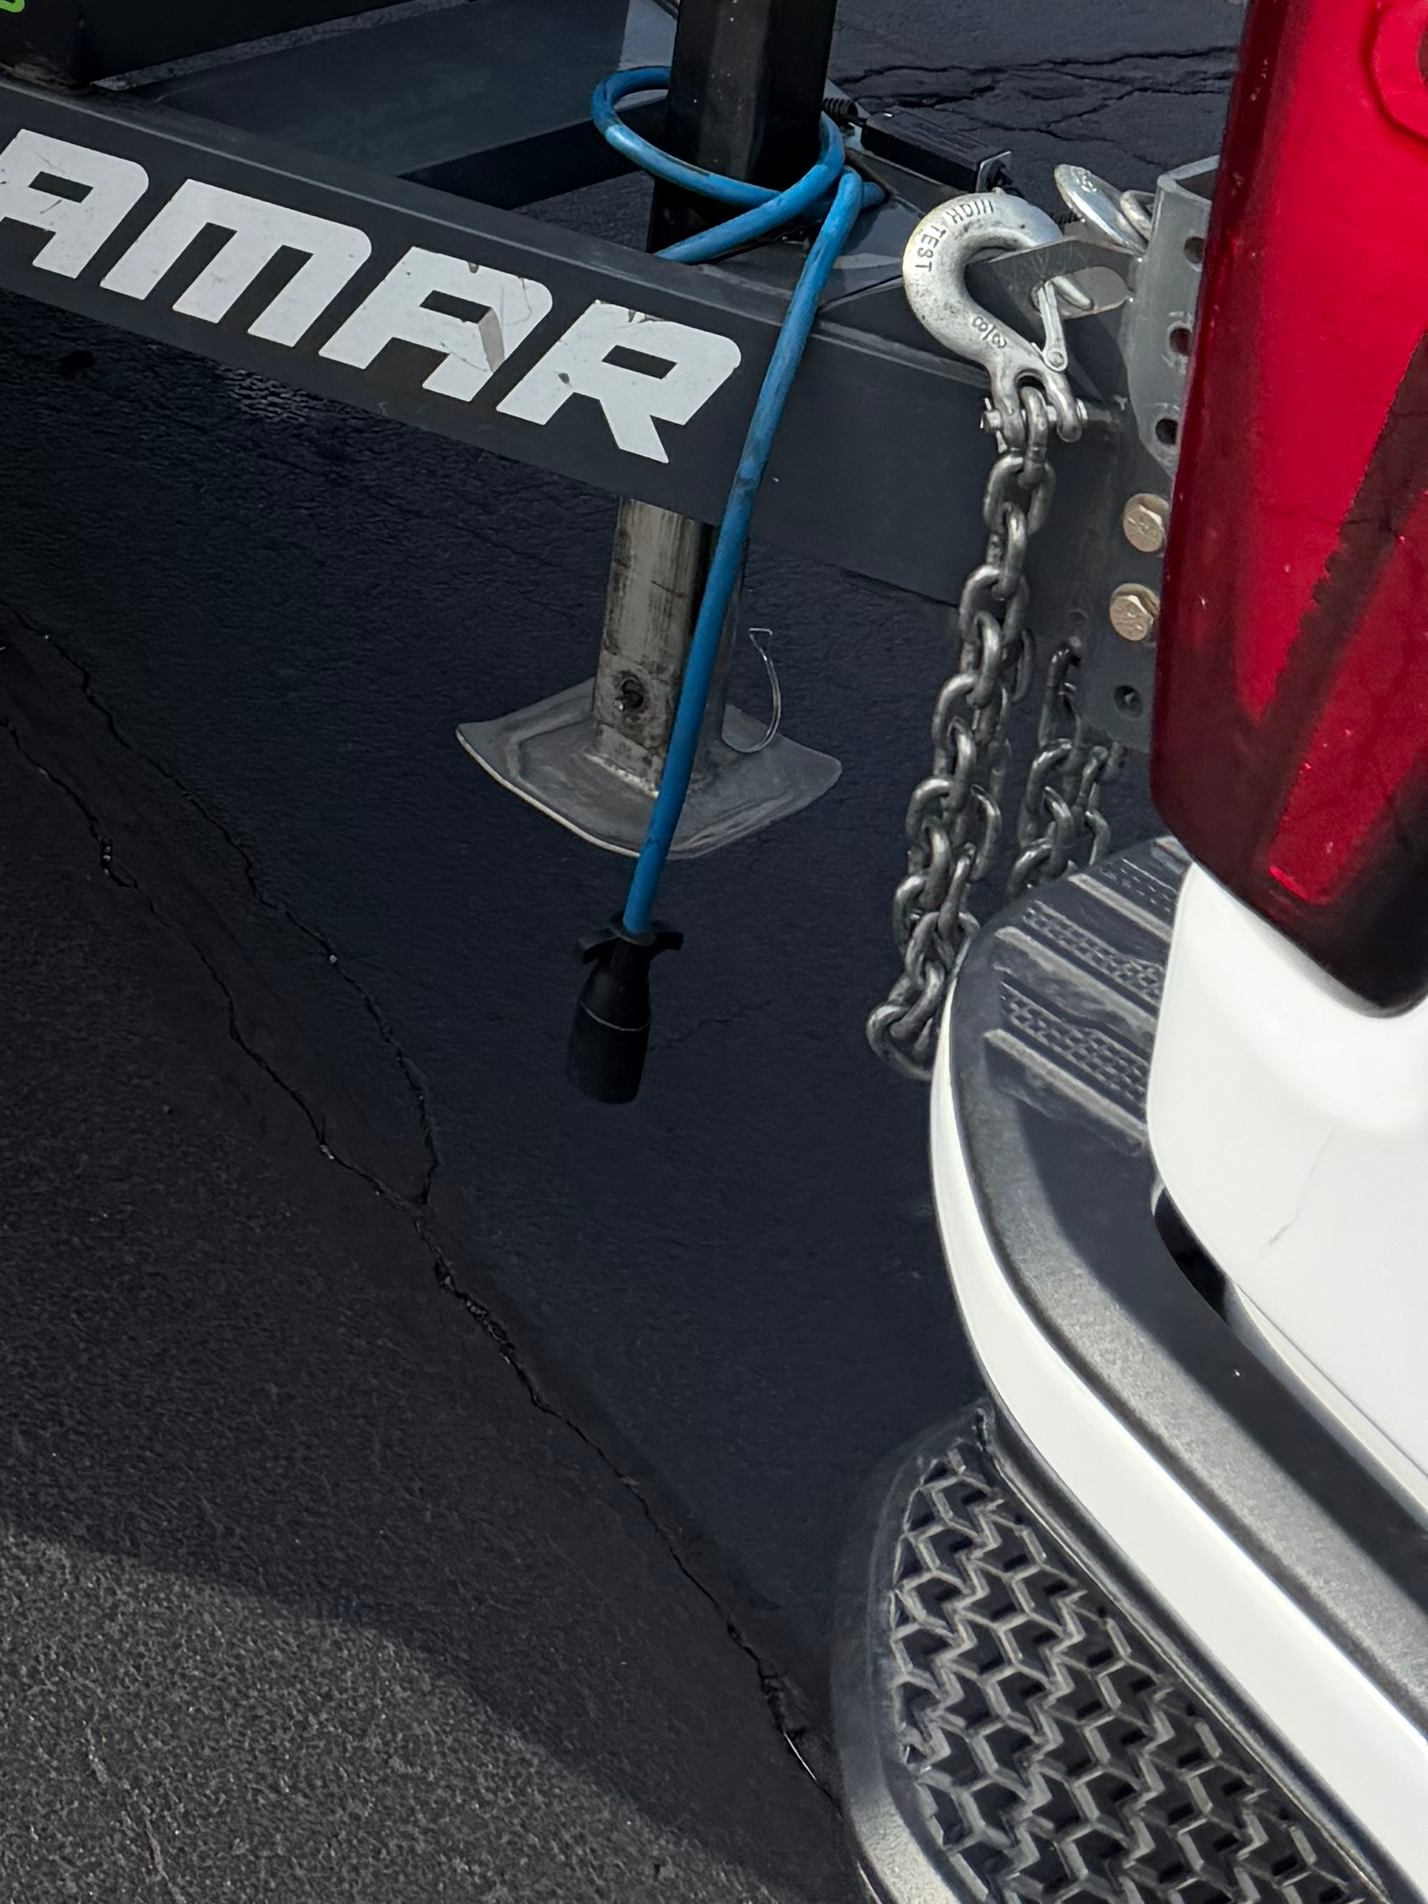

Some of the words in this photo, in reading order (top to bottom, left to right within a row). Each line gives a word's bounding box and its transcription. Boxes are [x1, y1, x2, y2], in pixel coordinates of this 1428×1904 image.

[946, 199, 994, 224] HIGH
[914, 225, 946, 273] TEST
[971, 316, 1007, 349] 3/8
